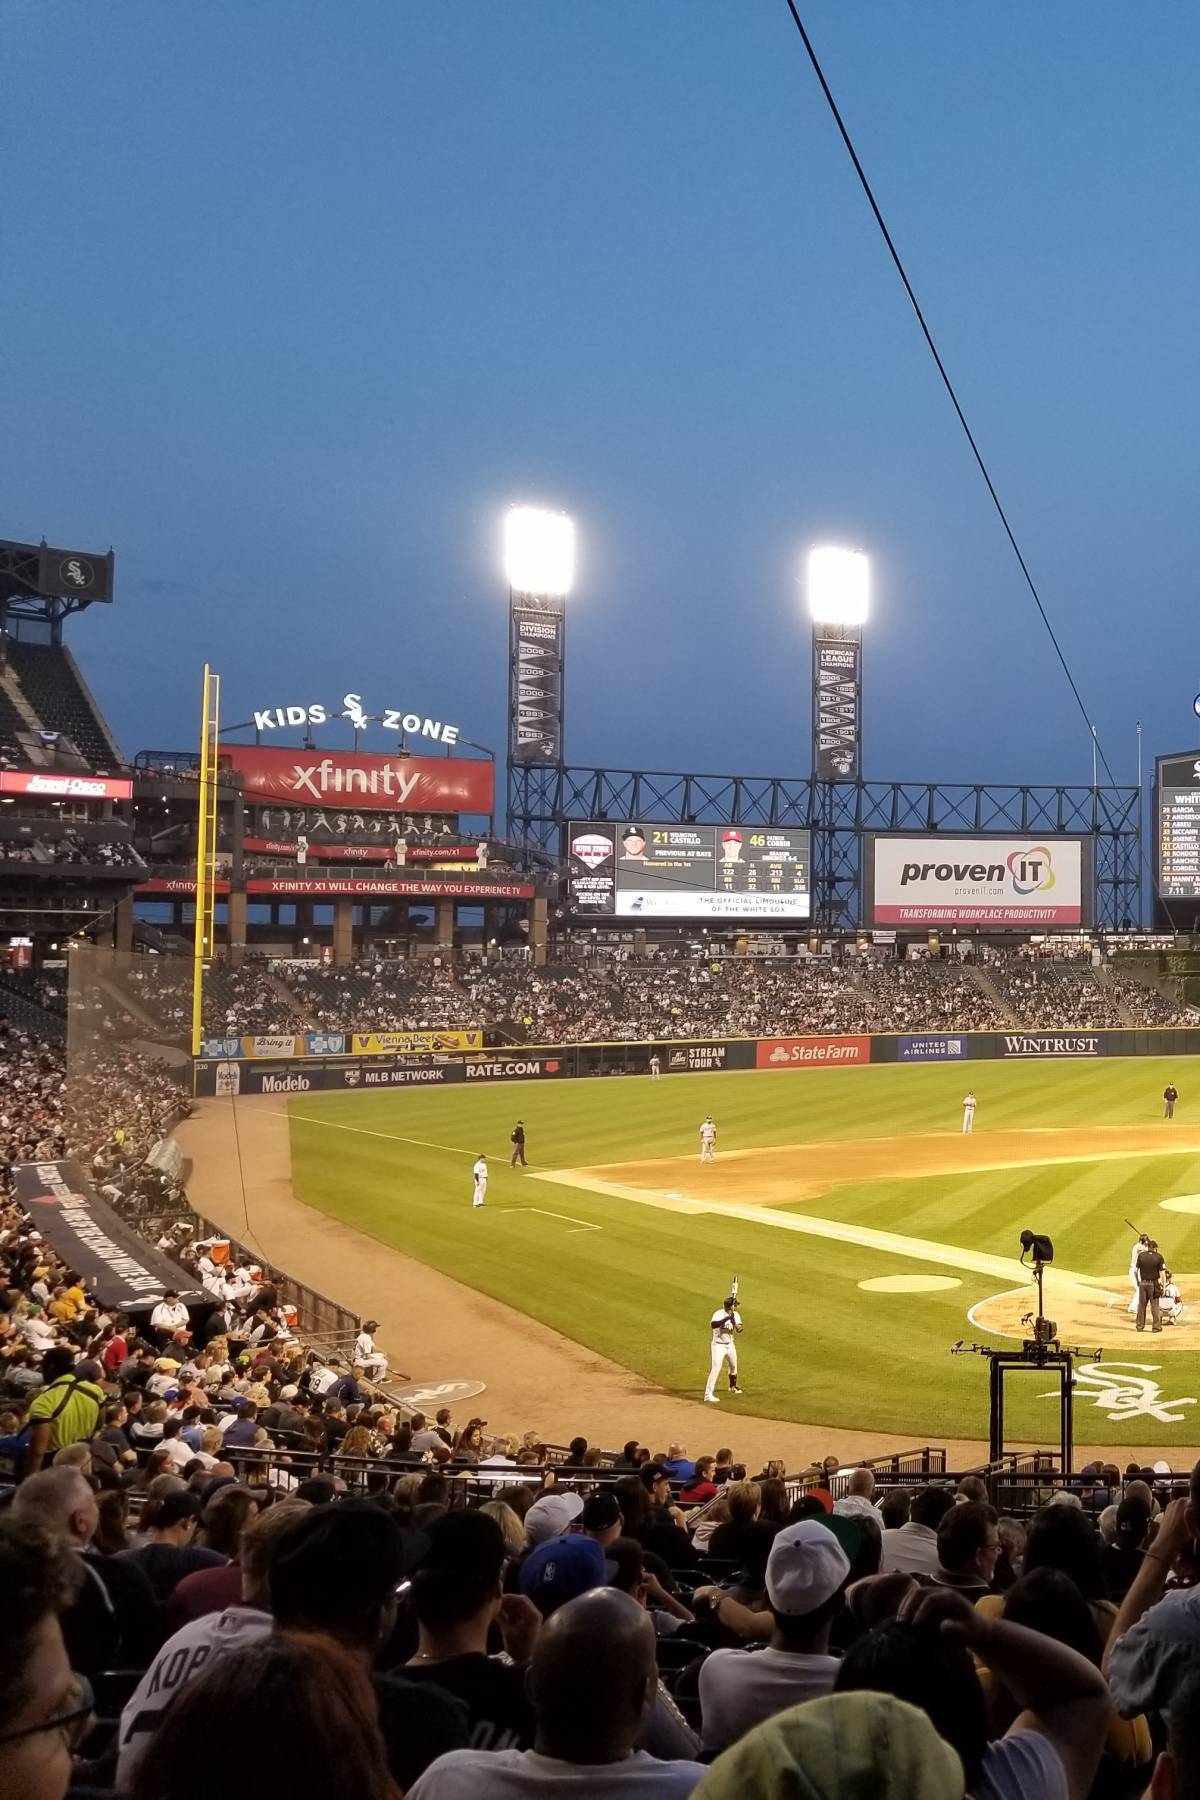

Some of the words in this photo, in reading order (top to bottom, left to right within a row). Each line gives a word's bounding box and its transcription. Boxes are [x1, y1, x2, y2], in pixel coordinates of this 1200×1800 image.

[520, 625, 556, 634] DIVISION
[821, 655, 854, 663] LEAGUE
[254, 704, 327, 730] KIDS
[383, 710, 459, 744] ZONE
[292, 760, 421, 803] xfinity
[653, 831, 668, 843] 21
[750, 835, 765, 846] 46
[1020, 861, 1042, 882] IT
[272, 882, 311, 890] XFINITY
[328, 882, 353, 891] WILL
[356, 883, 398, 891] CHANGE
[422, 884, 442, 892] WAY
[443, 885, 462, 893] YOU
[464, 886, 511, 894] EXPERIENCE
[954, 887, 1004, 896] provenIT.com
[899, 908, 957, 919] TRANSFORMING
[958, 909, 1002, 919] WORKPLACE
[1004, 909, 1056, 920] PRODUCTIVITY
[256, 1037, 284, 1047] Bring
[285, 1039, 293, 1047] it
[413, 1033, 435, 1043] Beef
[689, 1047, 725, 1058] STREAM
[904, 1047, 946, 1055] AIRLINES
[689, 1058, 712, 1068] YOUR
[466, 1062, 540, 1077] RATE.COM
[365, 1072, 389, 1083] MLB
[391, 1070, 444, 1082] NETWORK
[262, 1075, 310, 1093] Modelo
[76, 1235, 129, 1259] CHICAGO
[102, 1256, 150, 1278] WHITE
[121, 1275, 167, 1292] SOX
[145, 1645, 221, 1700] KOP
